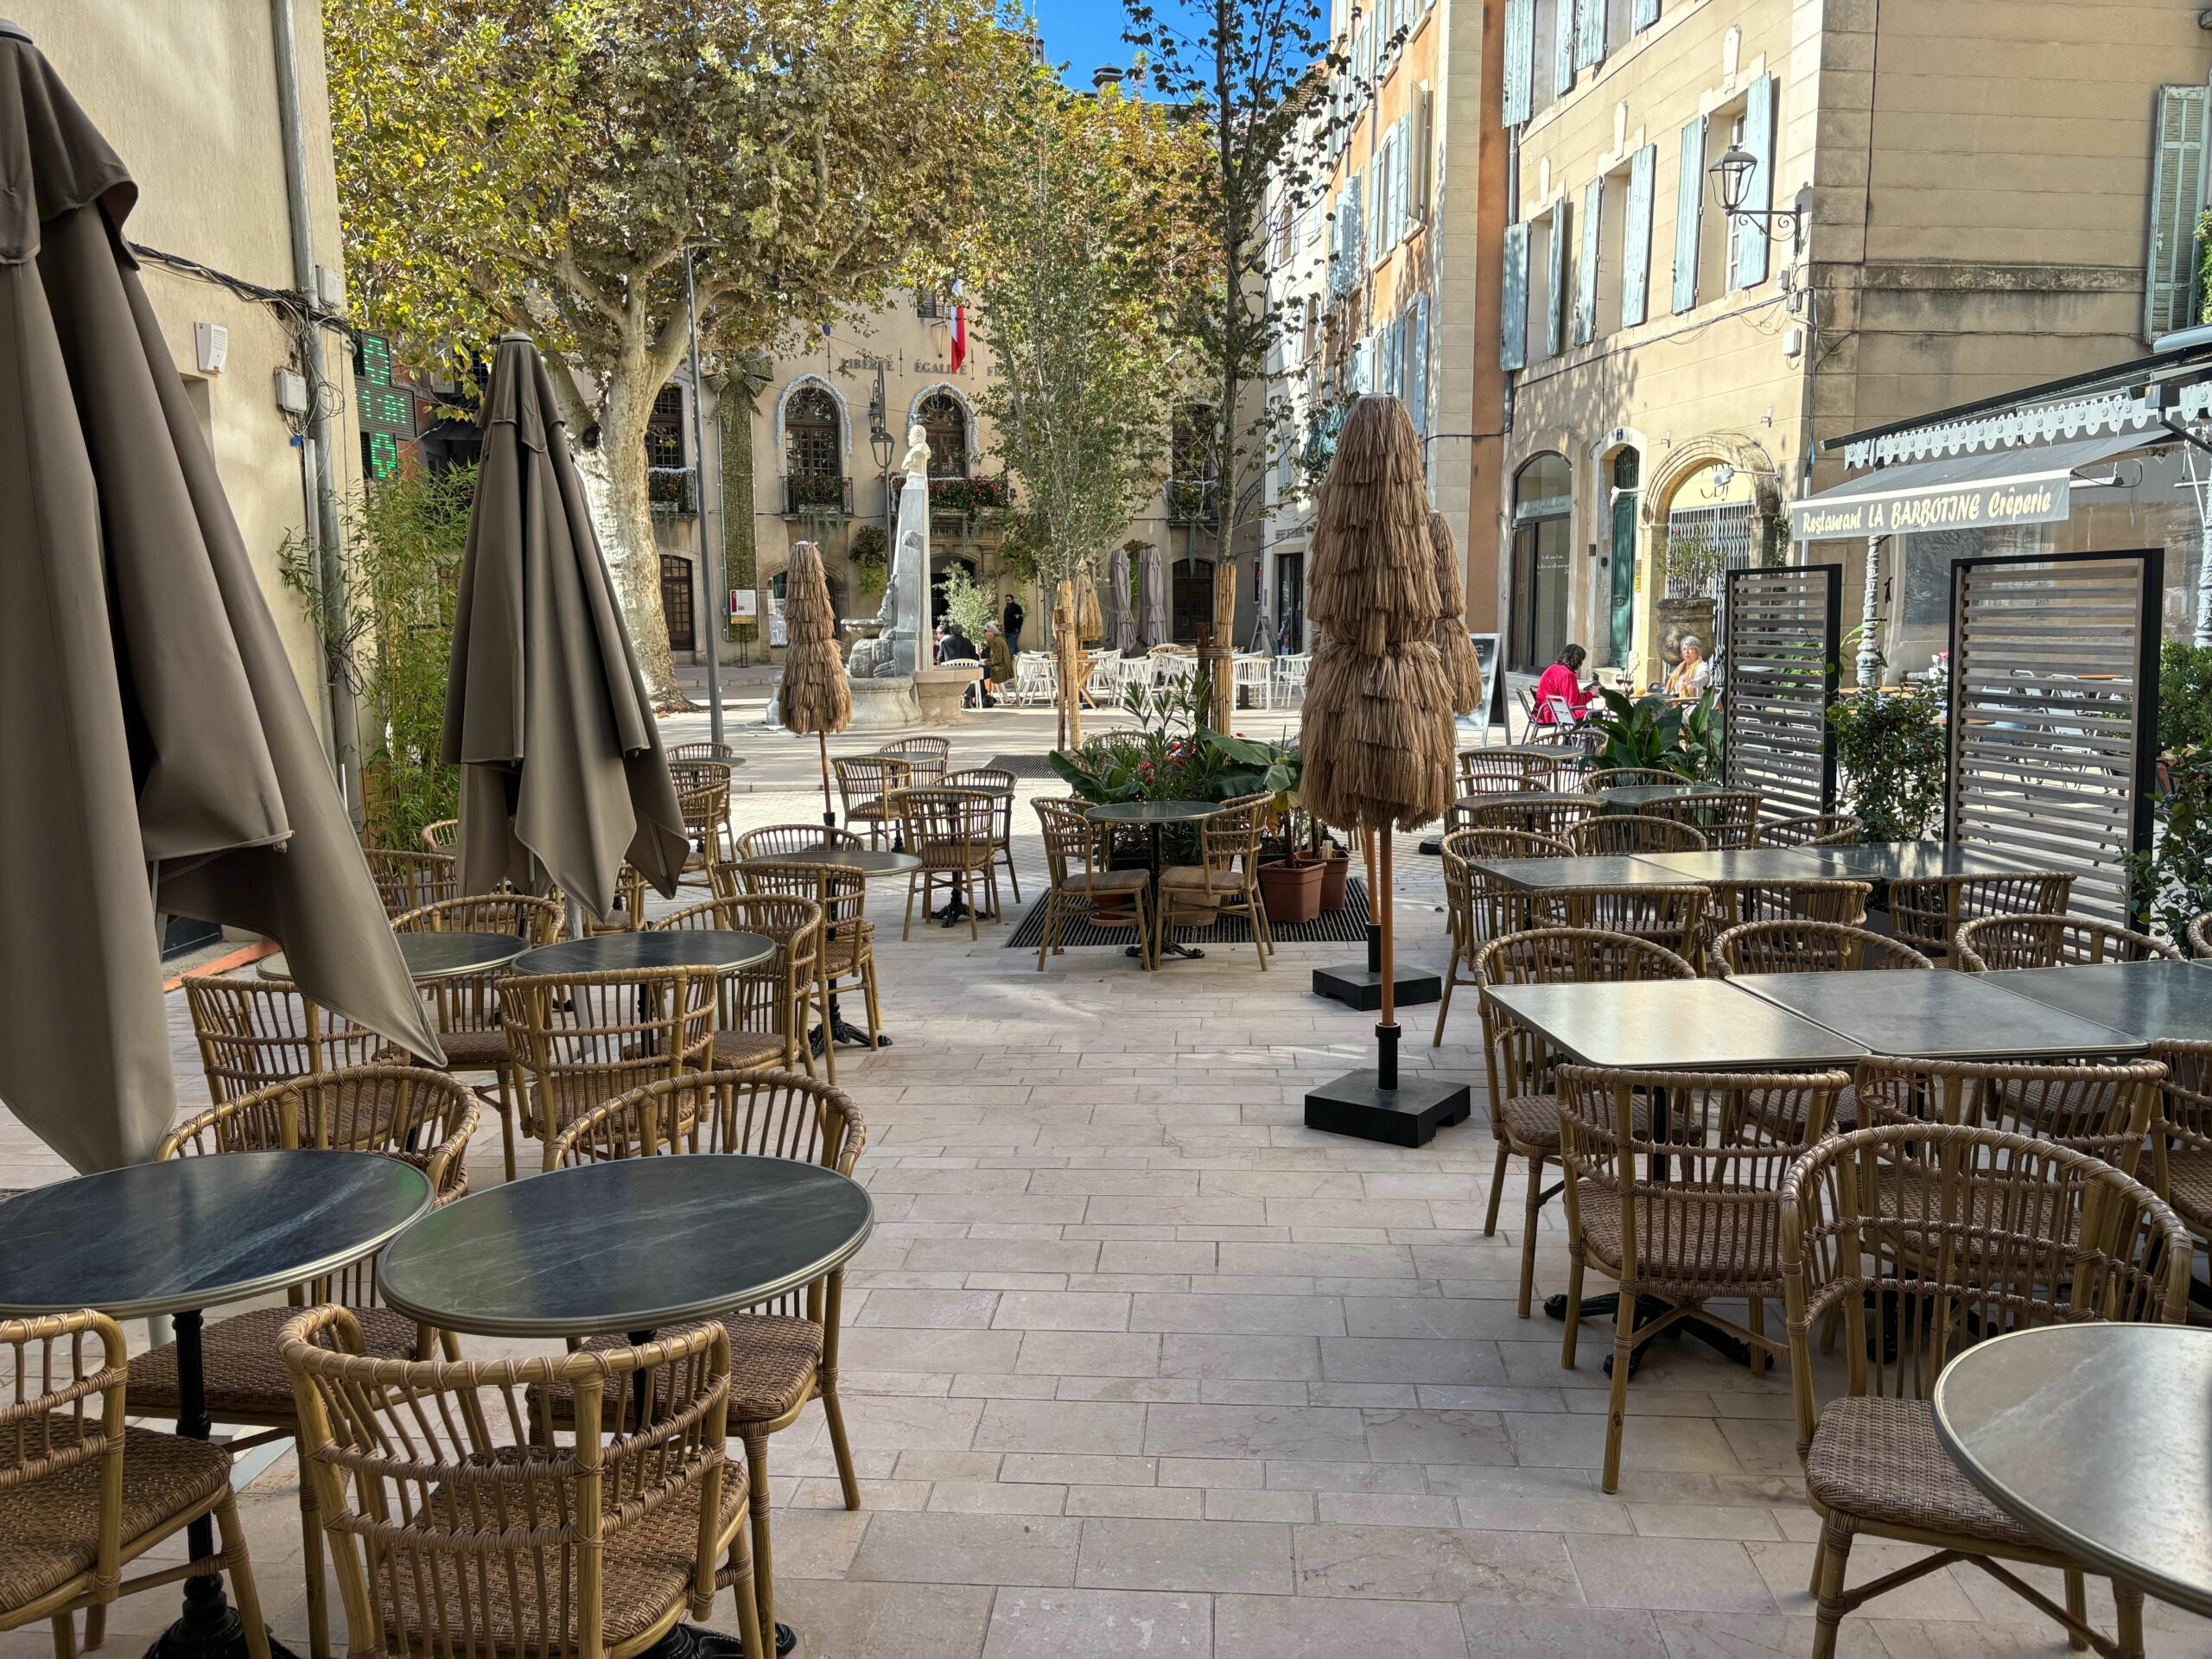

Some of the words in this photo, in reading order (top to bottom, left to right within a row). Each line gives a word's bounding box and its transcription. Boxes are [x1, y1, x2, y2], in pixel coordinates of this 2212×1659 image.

[842, 357, 894, 372] IBERÉ
[913, 359, 968, 375] ÉGALIÉ
[1802, 505, 1861, 534] Restaurant
[1868, 504, 1885, 529] LA
[1890, 494, 1980, 531] BARBOTINE
[1987, 485, 2051, 522] Crêperie
